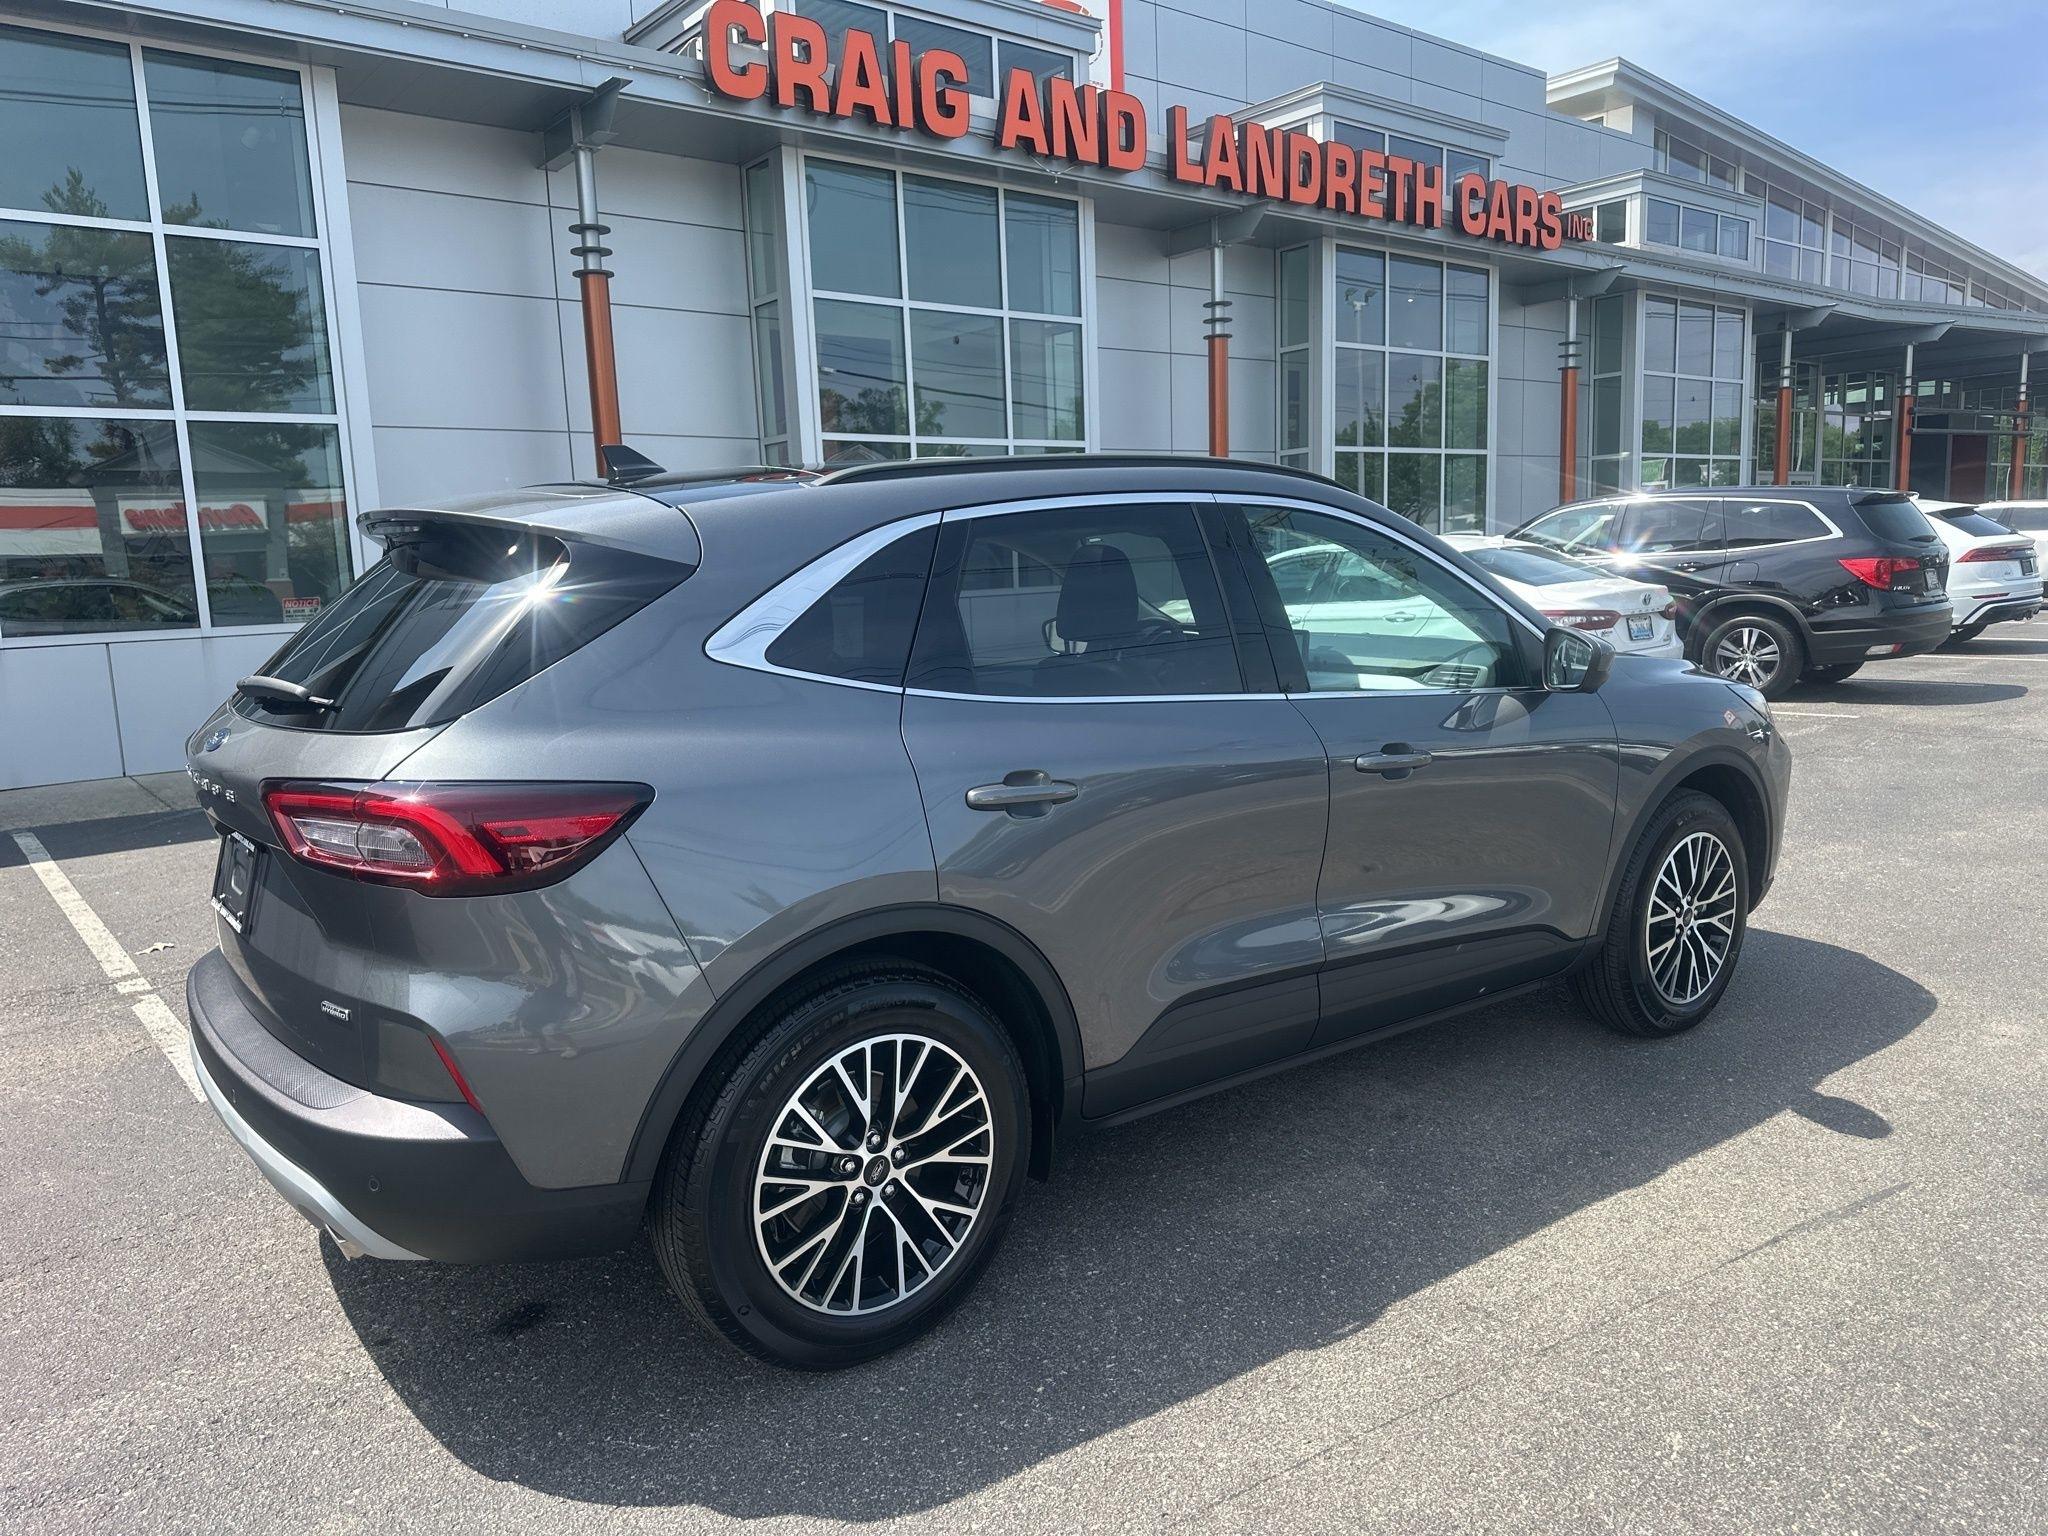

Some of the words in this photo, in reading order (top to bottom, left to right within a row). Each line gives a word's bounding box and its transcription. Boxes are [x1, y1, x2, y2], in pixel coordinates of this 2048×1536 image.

[704, 0, 970, 138] CRAIG
[1000, 67, 1147, 171] AND
[1167, 105, 1442, 228] LANDRETH
[1456, 173, 1563, 250] CARS
[284, 600, 319, 608] NOTICE
